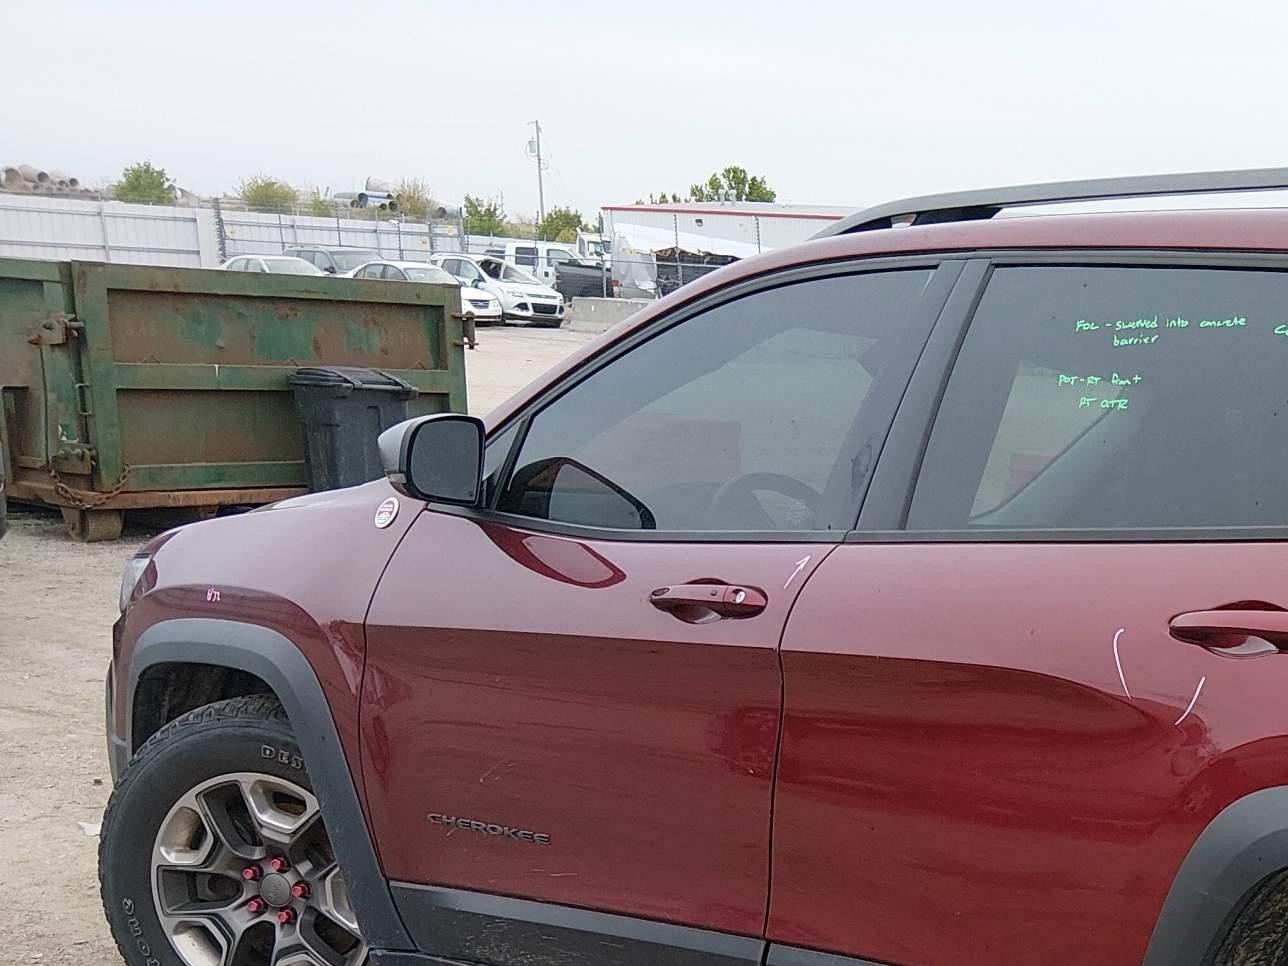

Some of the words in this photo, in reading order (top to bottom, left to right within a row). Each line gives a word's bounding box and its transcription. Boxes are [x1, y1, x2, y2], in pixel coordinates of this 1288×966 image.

[1165, 316, 1190, 328] into
[1199, 316, 1247, 328] concrete
[1113, 334, 1160, 347] barrier
[427, 812, 552, 846] CHEROKEE
